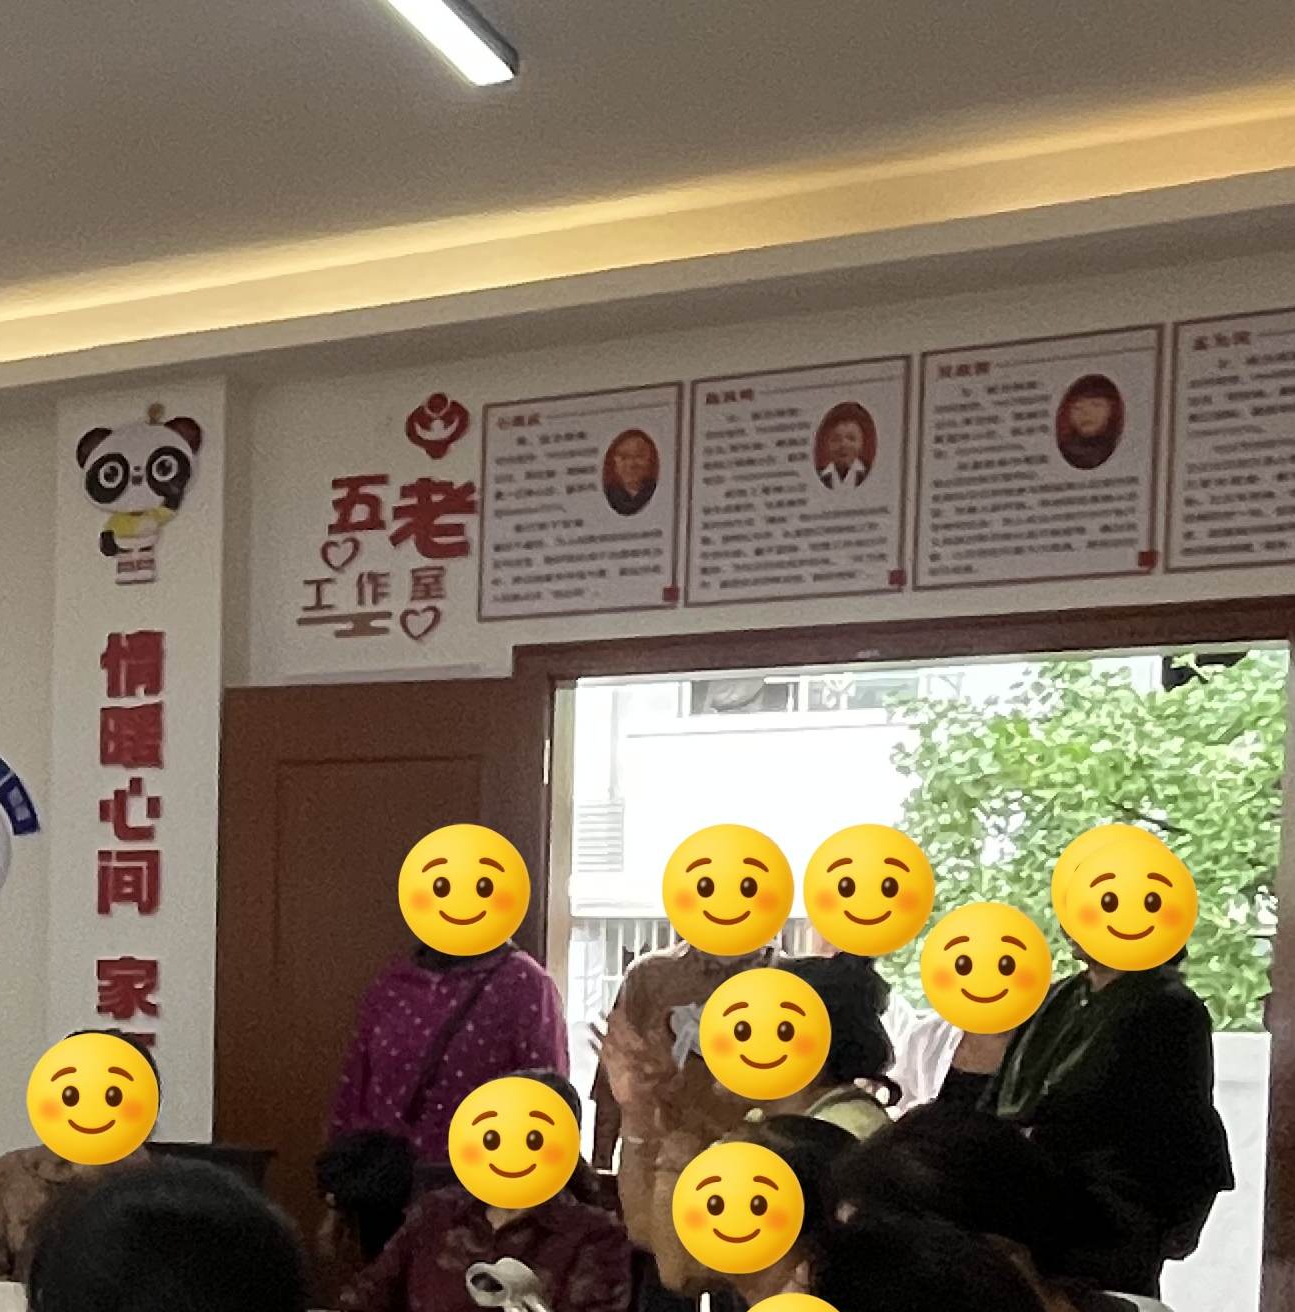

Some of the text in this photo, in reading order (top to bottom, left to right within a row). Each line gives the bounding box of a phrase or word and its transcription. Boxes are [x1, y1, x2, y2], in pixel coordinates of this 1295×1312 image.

[329, 474, 478, 559] 五老
[302, 566, 448, 611] 工作室
[96, 631, 166, 1047] 情暖心间 家
